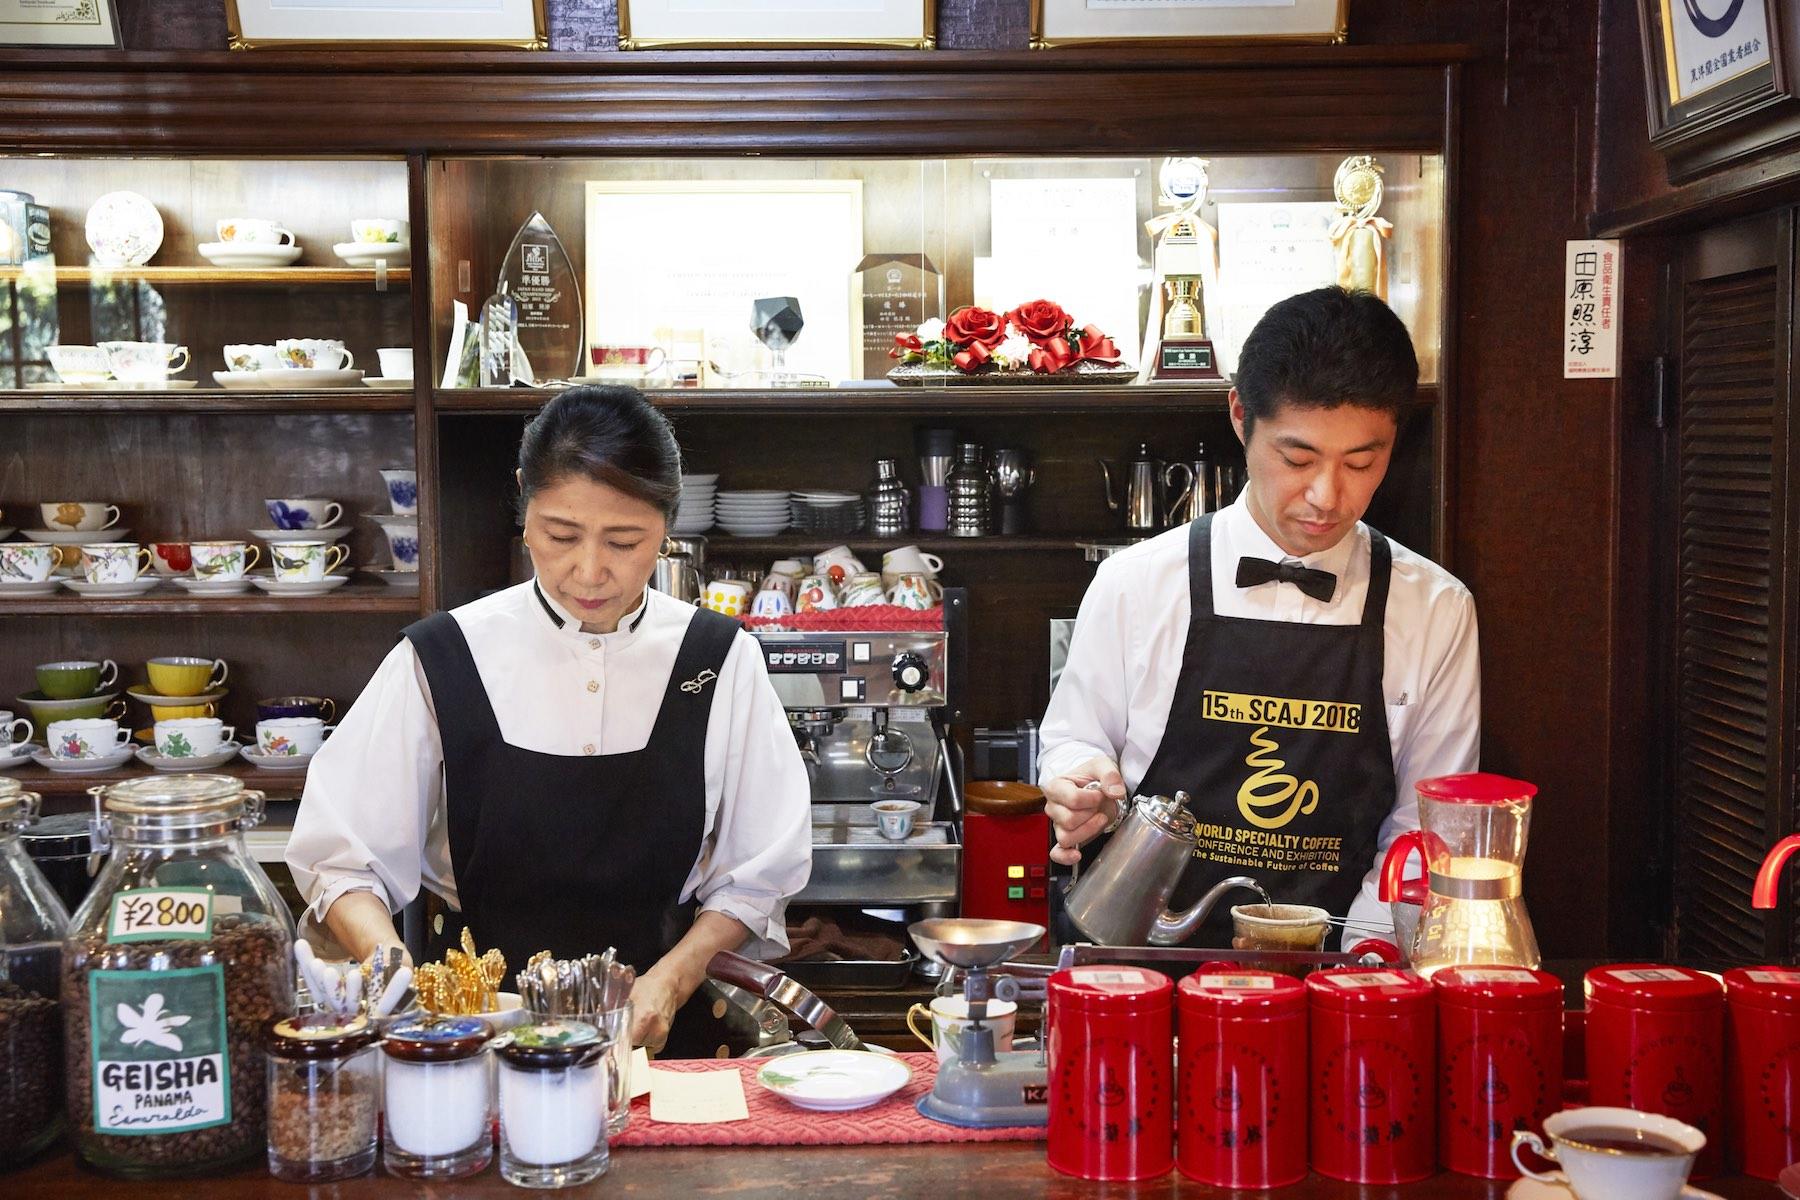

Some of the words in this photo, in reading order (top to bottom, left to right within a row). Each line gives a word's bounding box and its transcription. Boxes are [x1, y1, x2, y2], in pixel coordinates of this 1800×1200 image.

[1570, 251, 1598, 355] 田原照淳
[1202, 693, 1244, 720] 15th
[1248, 698, 1307, 726] SCAJ
[1311, 704, 1361, 730] 2018
[1195, 822, 1233, 841] WORLD
[1234, 828, 1300, 850] SPECIALTY
[1302, 836, 1343, 850] COFFEE
[1197, 838, 1259, 857] ONFERENCE
[1261, 848, 1284, 860] AND
[1286, 850, 1340, 862] EXHIBITION
[1209, 851, 1264, 868] Sustainable
[1266, 860, 1297, 871] Future
[1298, 862, 1308, 871] of
[1309, 862, 1340, 873] Coffee
[122, 896, 206, 931] ¥2800
[102, 1057, 219, 1092] GEISHA
[134, 1090, 193, 1110] PANAMA
